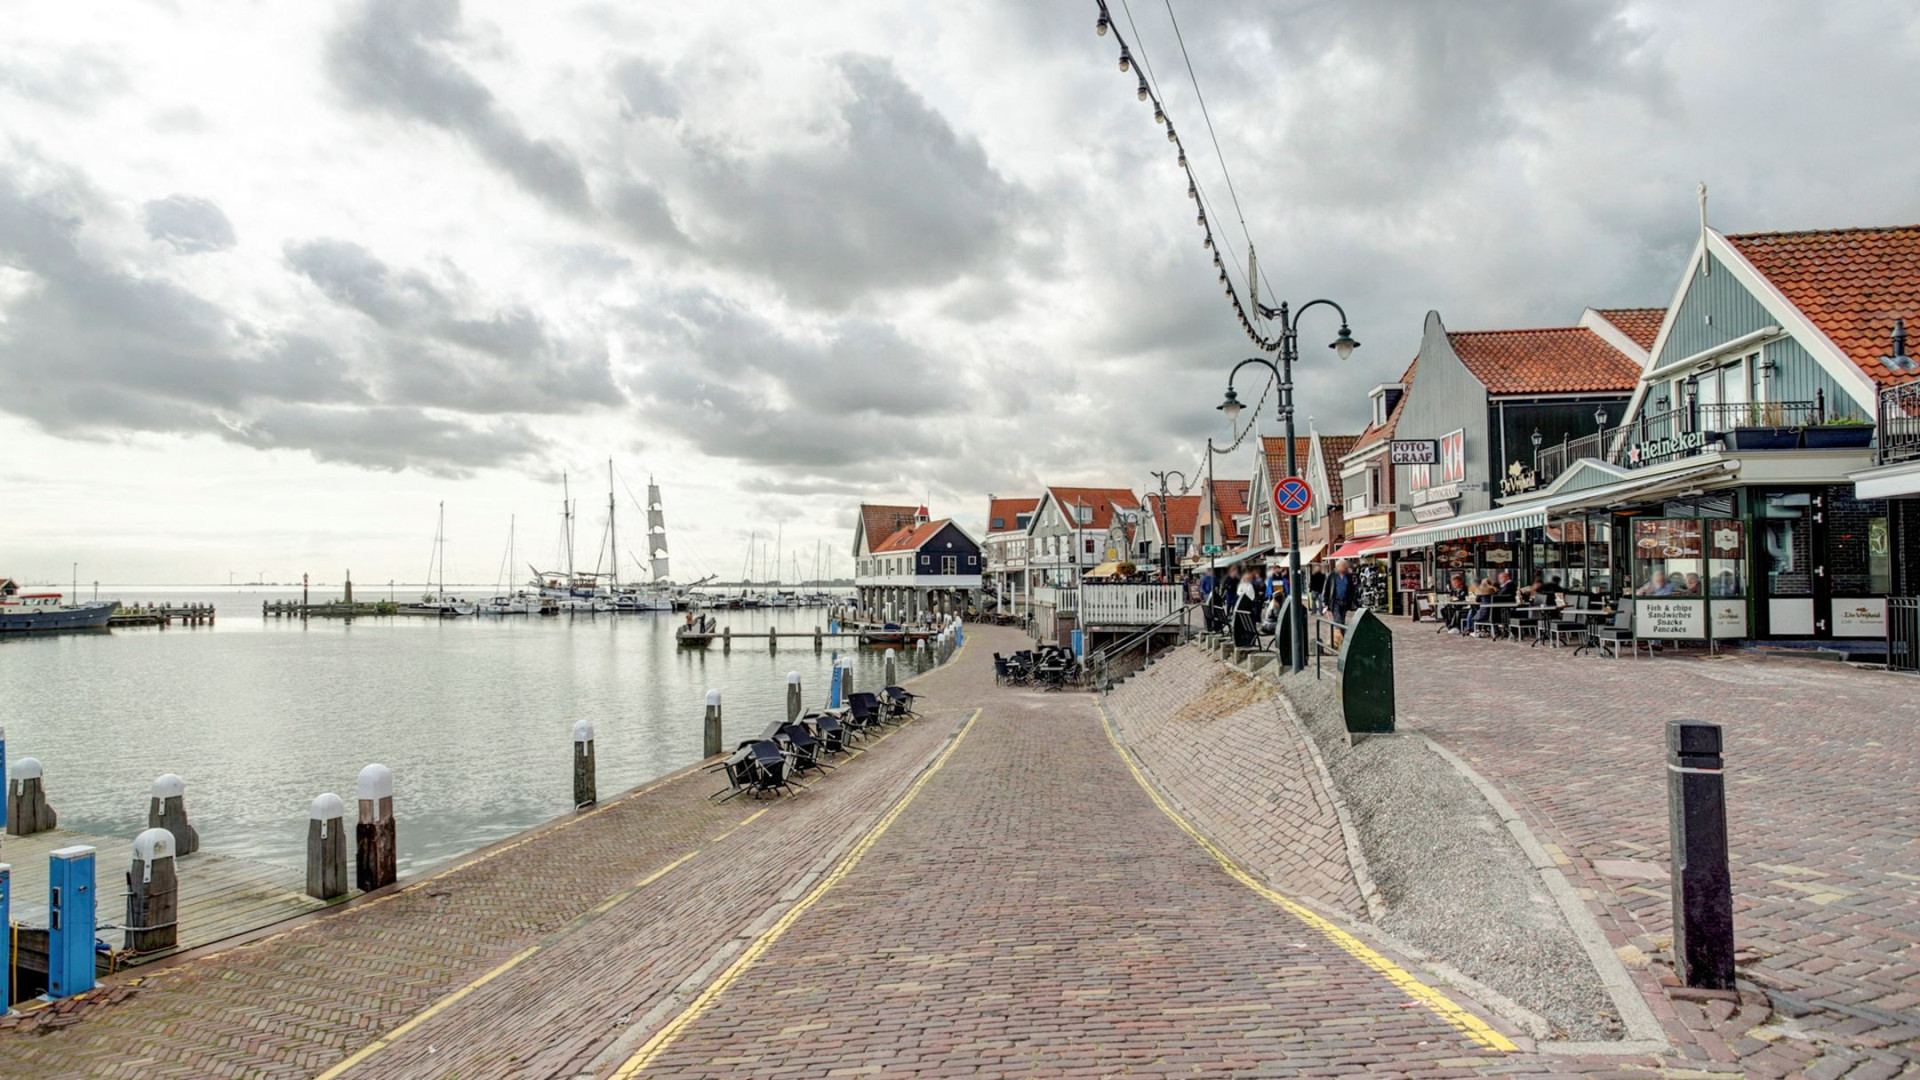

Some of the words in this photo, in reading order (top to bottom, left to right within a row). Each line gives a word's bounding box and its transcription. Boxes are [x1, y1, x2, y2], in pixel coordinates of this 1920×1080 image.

[1393, 442, 1430, 452] FOTO-
[1640, 431, 1705, 460] Heineken
[1393, 453, 1432, 463] GRAAF
[1673, 604, 1692, 612] chips
